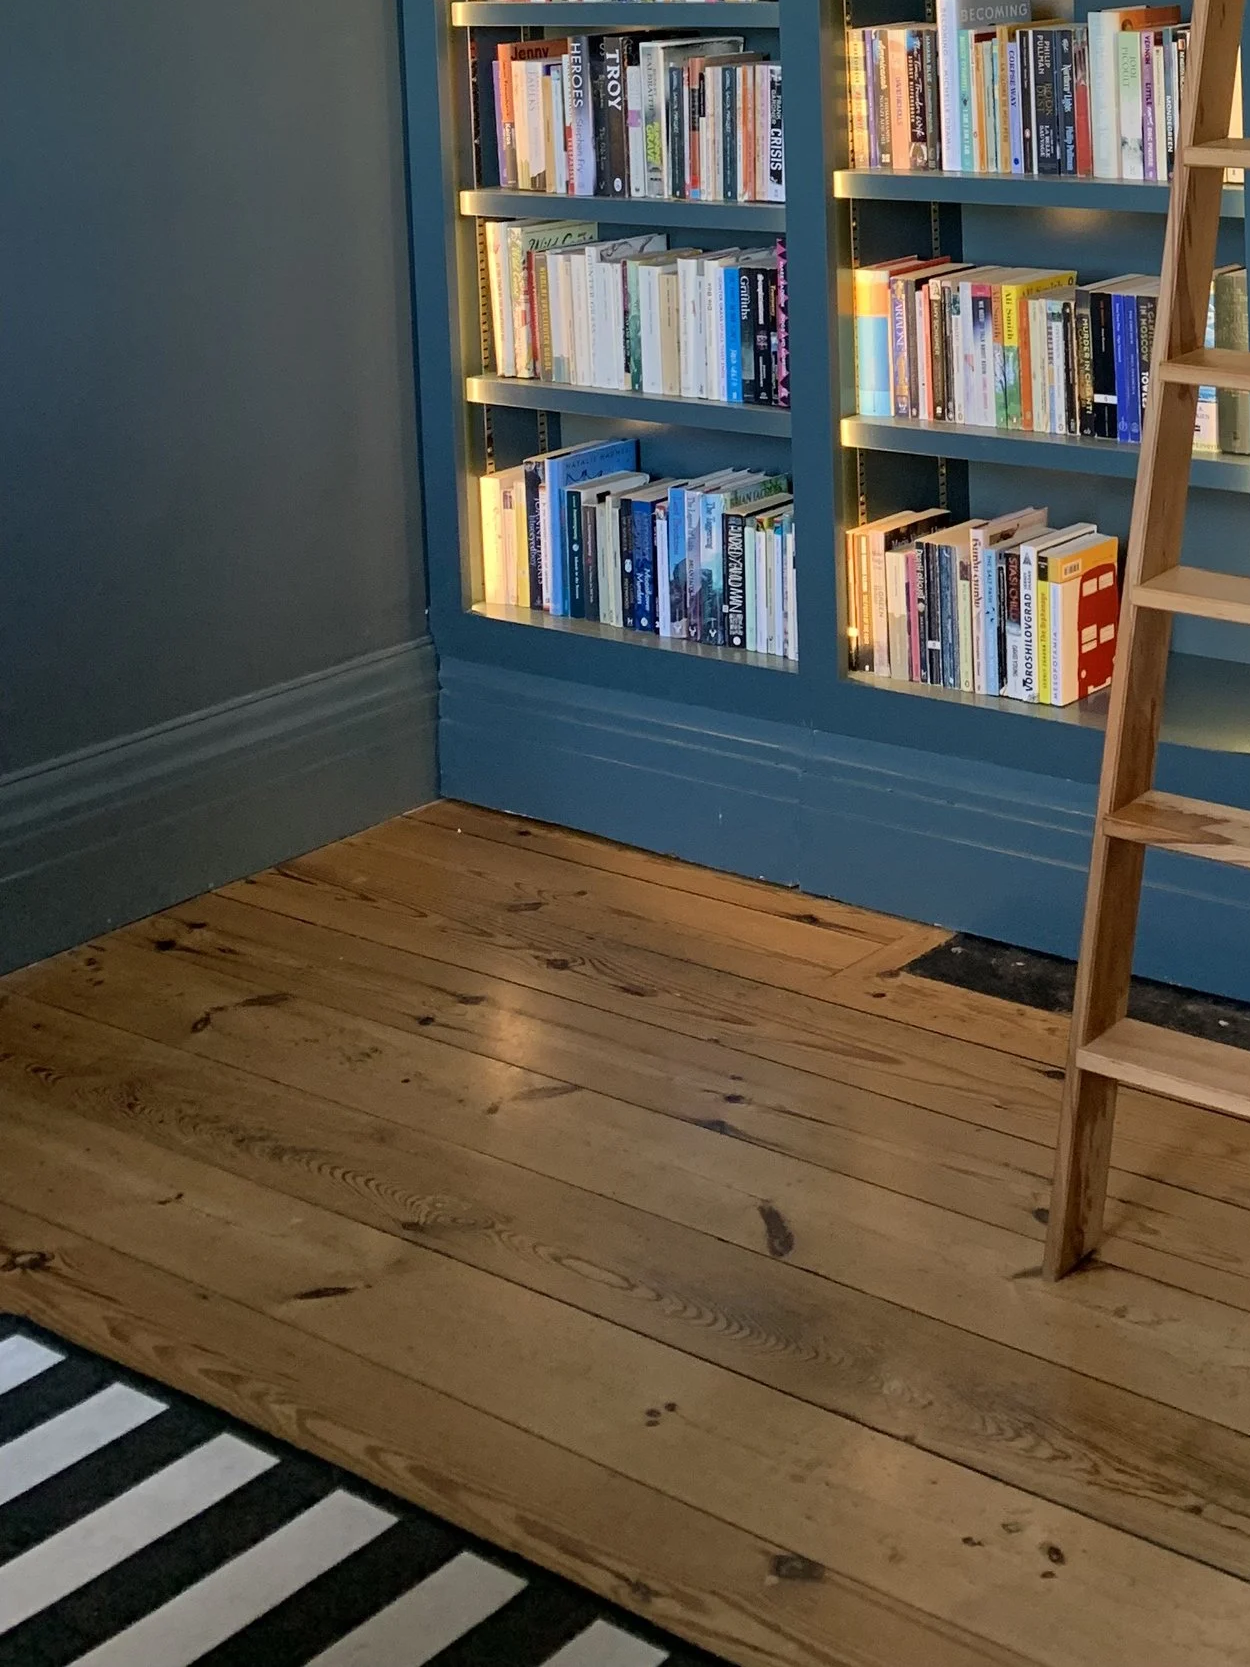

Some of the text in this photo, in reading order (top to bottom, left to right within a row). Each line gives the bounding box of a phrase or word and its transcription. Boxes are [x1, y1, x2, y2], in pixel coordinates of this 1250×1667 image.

[960, 3, 1028, 23] BECOMING
[571, 42, 583, 108] HEROES
[878, 39, 888, 90] Americanah
[1008, 50, 1016, 86] CORPSE
[1037, 35, 1045, 75] PULLMAN
[1121, 47, 1129, 88] PICOULT
[605, 48, 622, 111] TROY
[770, 128, 782, 174] CRISIS
[740, 275, 750, 320] Griffiths
[1004, 291, 1014, 340] Ali Smith
[1082, 318, 1091, 372] MURDER IN
[1140, 318, 1149, 362] MOSCOW
[705, 501, 715, 515] The
[1008, 557, 1019, 586] STASI
[1023, 594, 1034, 692] VOROSHILOVGRAD
